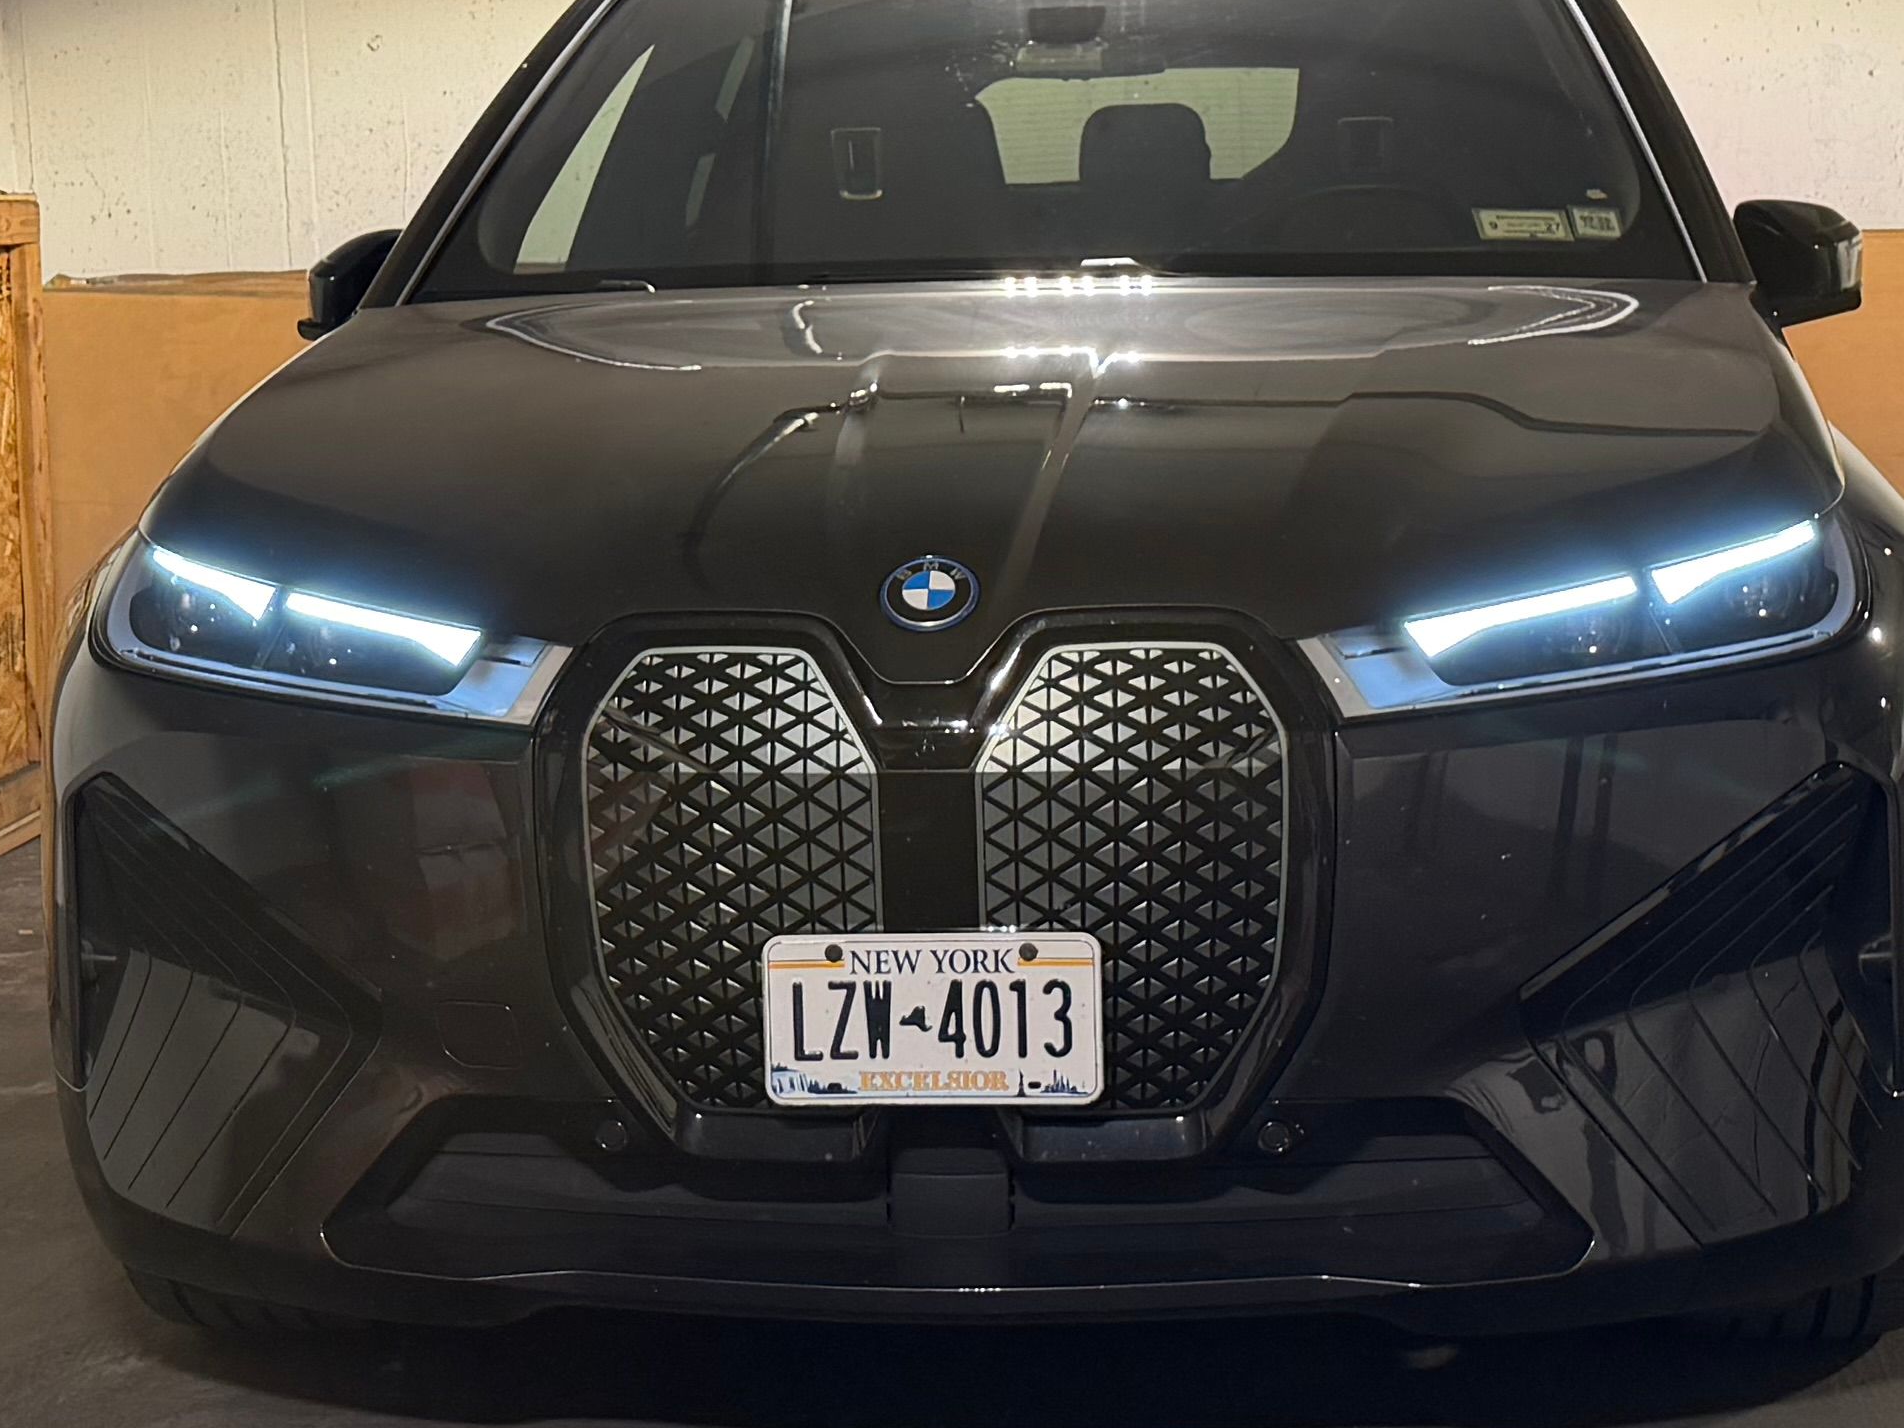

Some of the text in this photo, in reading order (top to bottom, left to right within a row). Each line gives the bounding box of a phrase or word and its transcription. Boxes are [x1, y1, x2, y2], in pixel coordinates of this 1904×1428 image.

[897, 562, 966, 580] BMW
[850, 949, 1015, 974] NEW YORK
[792, 979, 1073, 1061] LZW 4013
[858, 1070, 1008, 1090] EXCELSIOR
